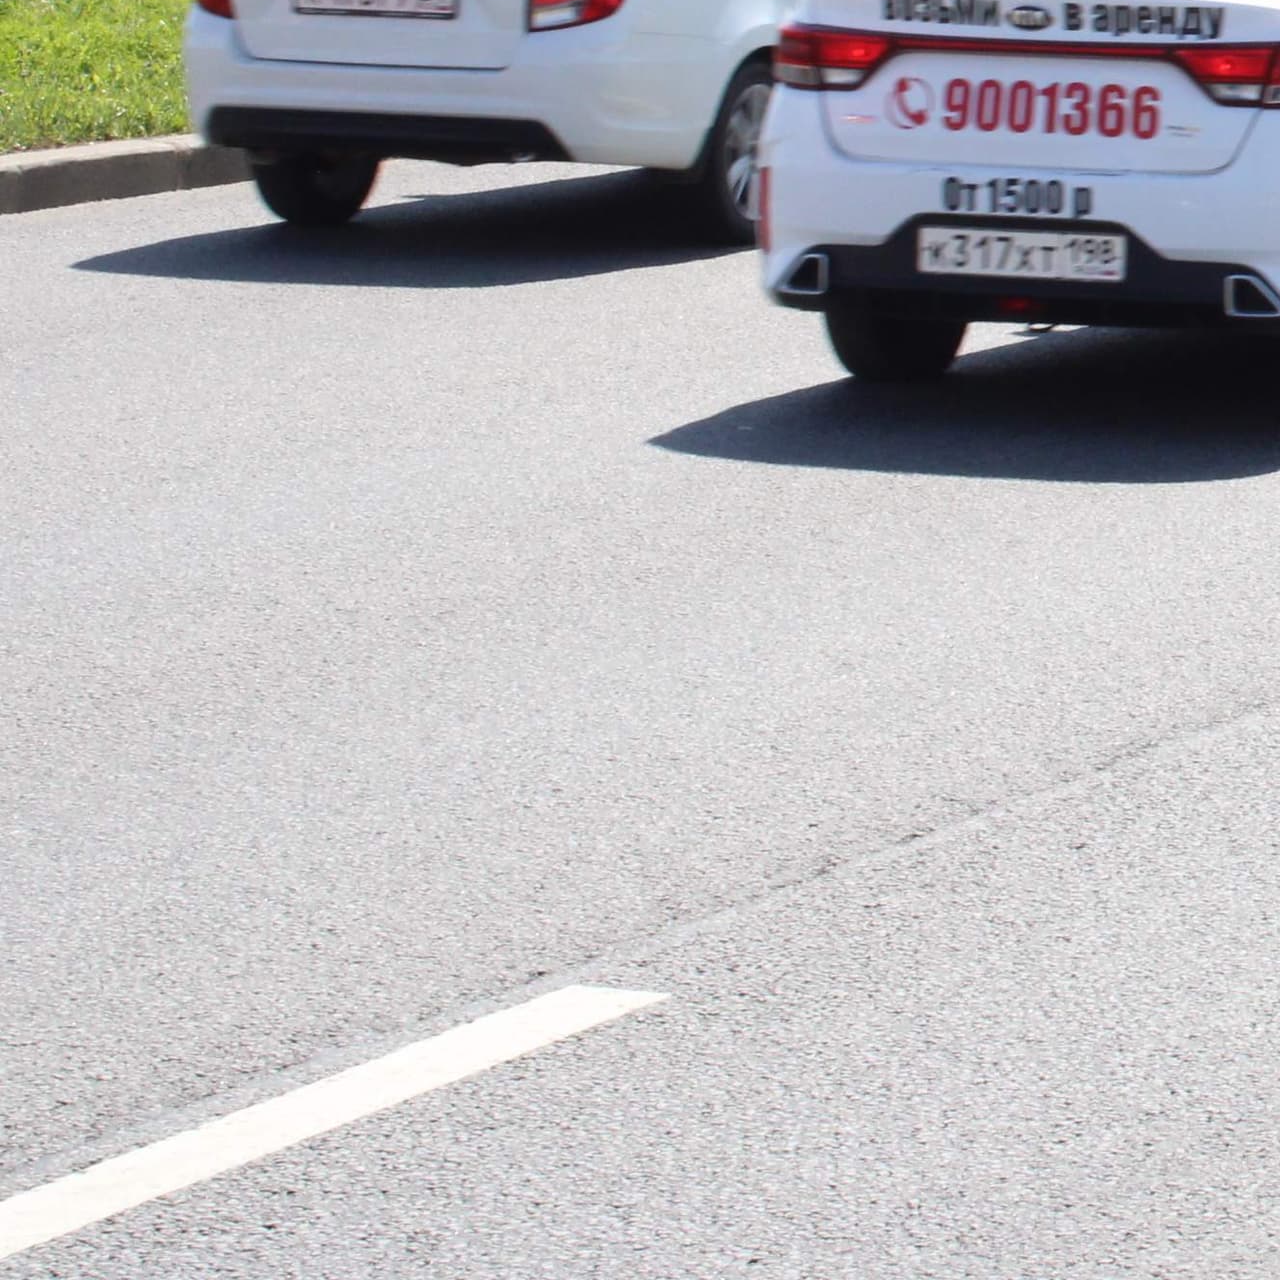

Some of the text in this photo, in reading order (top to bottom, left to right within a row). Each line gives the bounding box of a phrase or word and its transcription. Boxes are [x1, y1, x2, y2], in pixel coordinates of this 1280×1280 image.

[1091, 3, 1225, 40] аренду
[943, 77, 1163, 140] 9001366
[986, 177, 1063, 214] 1500
[925, 233, 1116, 270] К317ХТ 198
